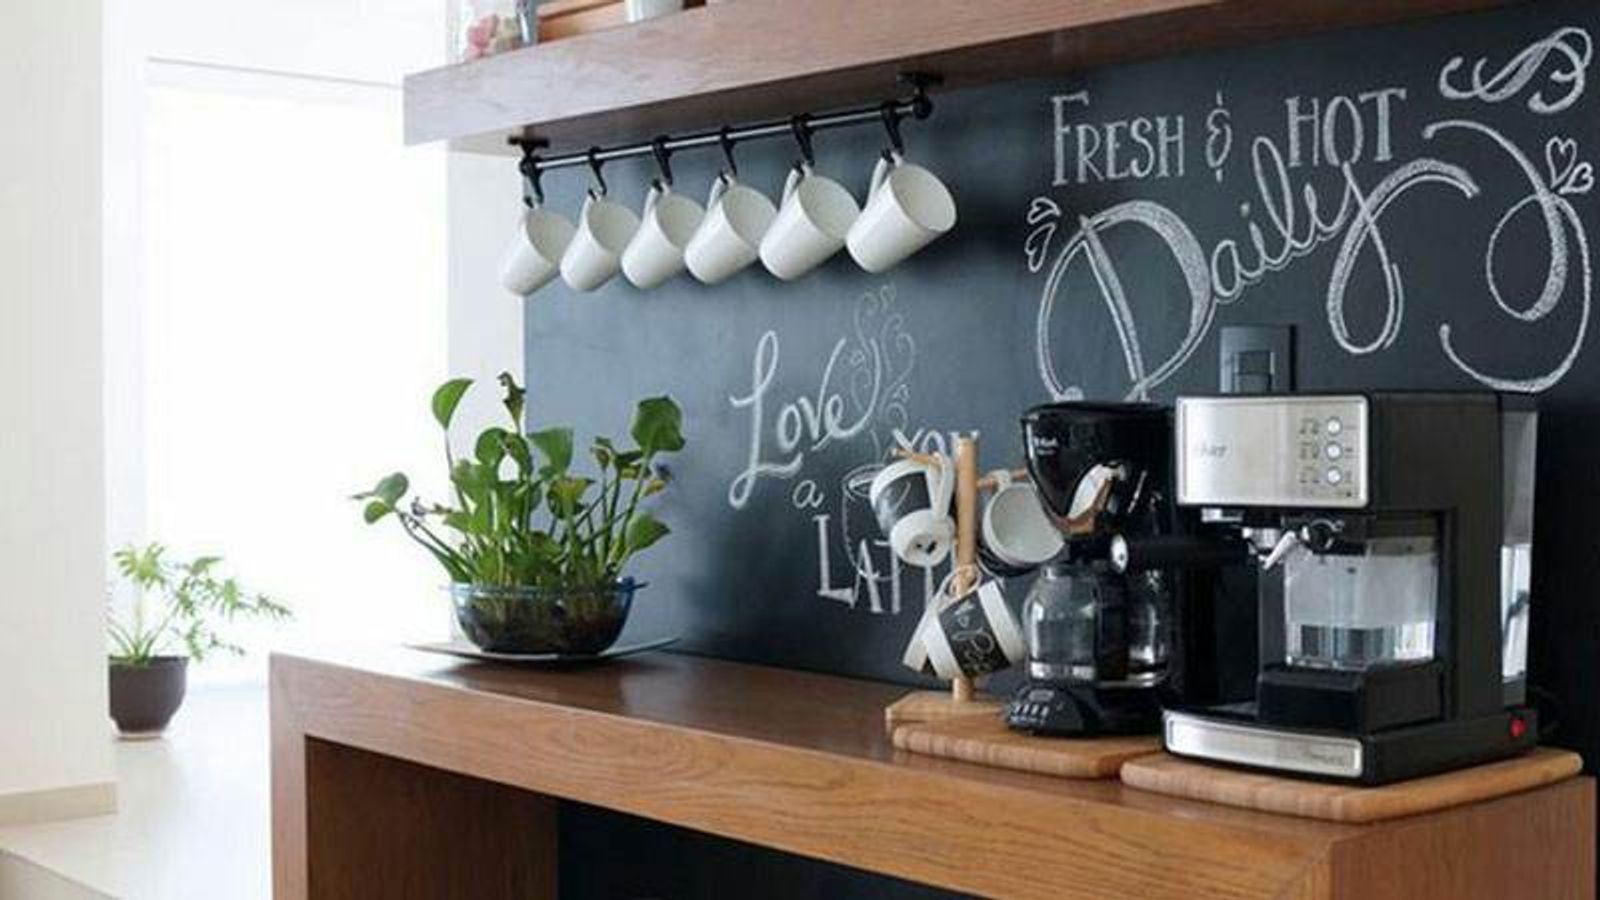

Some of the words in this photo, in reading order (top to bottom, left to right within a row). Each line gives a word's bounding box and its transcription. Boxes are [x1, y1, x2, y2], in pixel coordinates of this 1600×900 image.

[1206, 88, 1233, 183] &
[1285, 88, 1407, 169] HOT
[1037, 136, 1480, 402] Daily
[729, 330, 881, 510] Love
[792, 479, 824, 508] a
